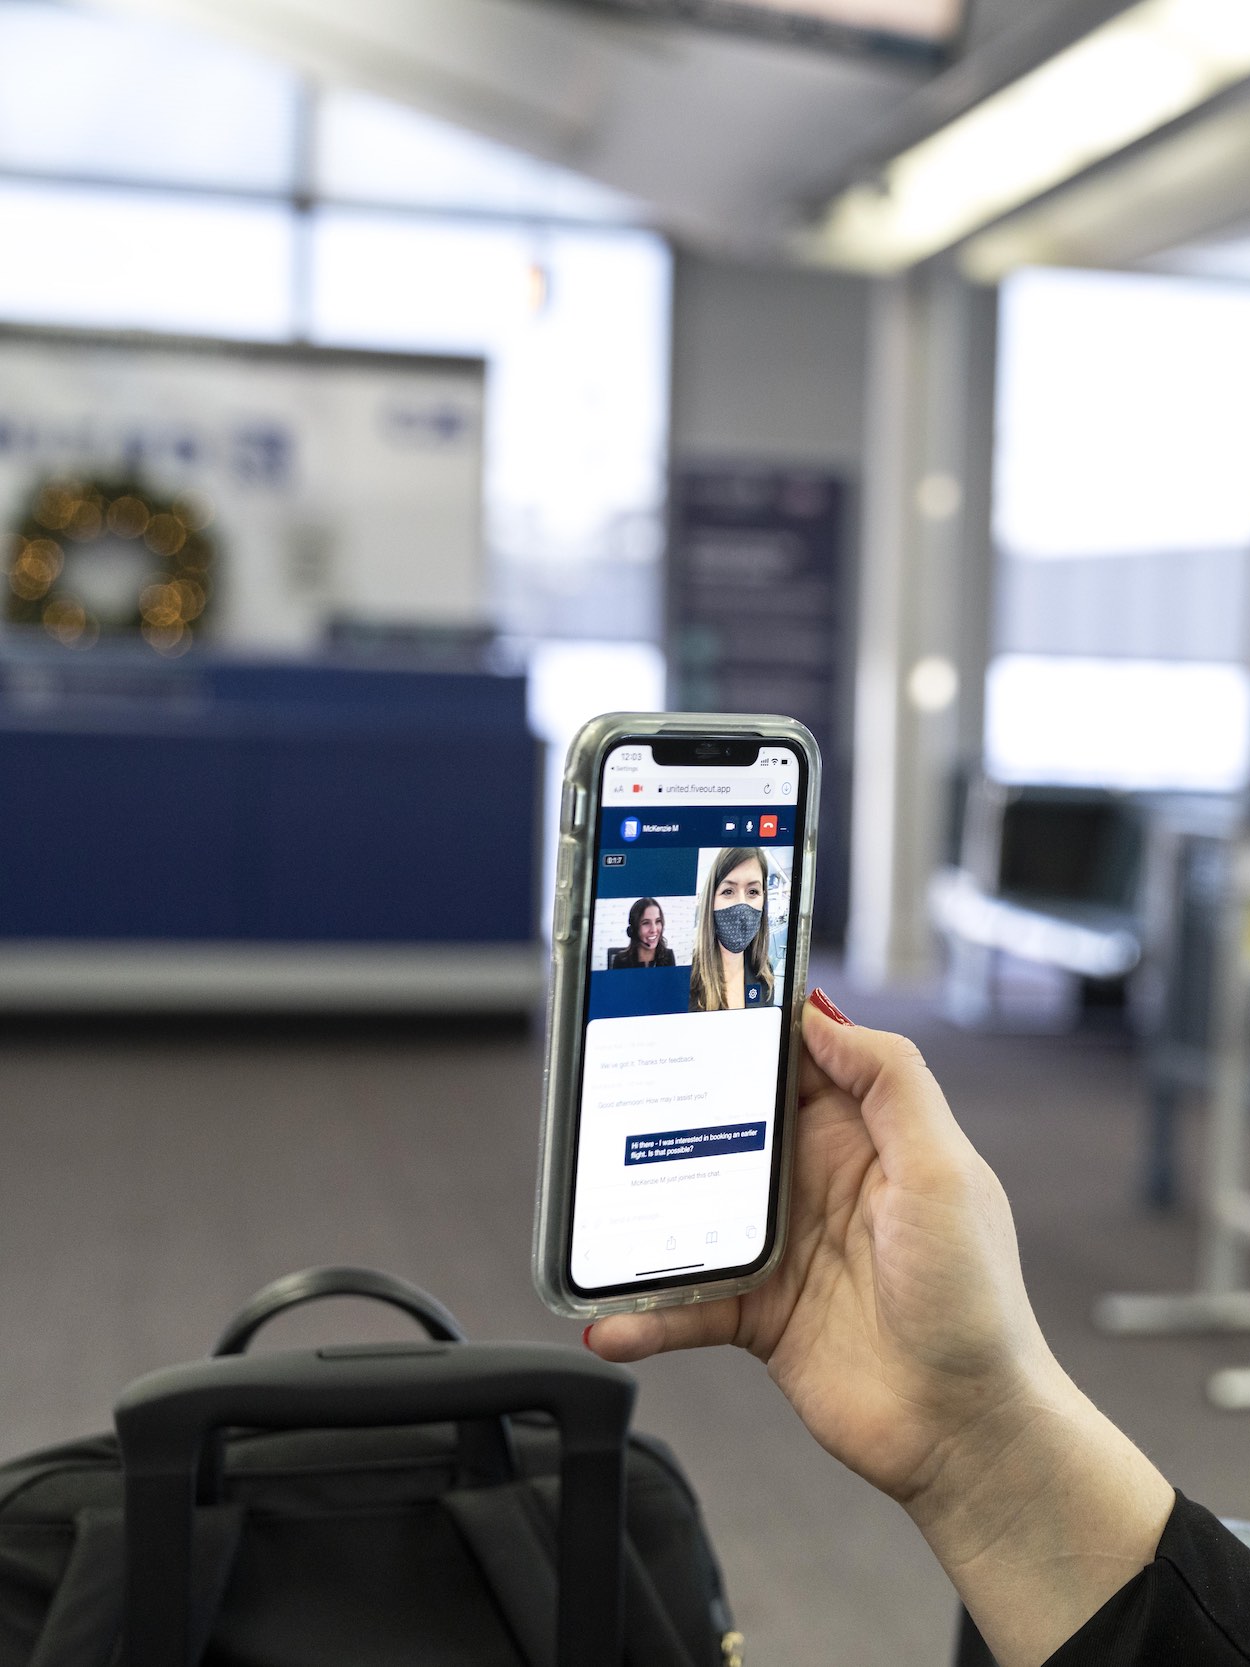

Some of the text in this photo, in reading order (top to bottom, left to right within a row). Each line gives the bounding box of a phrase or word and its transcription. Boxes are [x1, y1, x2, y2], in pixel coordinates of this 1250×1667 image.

[621, 752, 642, 761] 12:03
[666, 784, 730, 794] united.fiveout.app
[642, 824, 679, 832] McKenzie M
[619, 1060, 629, 1071] got
[637, 1058, 659, 1067] Thanks
[659, 1057, 668, 1065] for
[598, 1101, 614, 1109] Good
[645, 1096, 659, 1105] How
[660, 1096, 672, 1104] may
[676, 1093, 693, 1101] assist
[694, 1091, 709, 1101] you?
[631, 1141, 639, 1149] Hi
[639, 1140, 655, 1149] there
[662, 1138, 675, 1146] was
[675, 1134, 703, 1145] interested
[703, 1134, 709, 1142] in
[709, 1131, 732, 1141] booking
[732, 1131, 740, 1139] an
[740, 1128, 758, 1138] earlier
[630, 1144, 694, 1161] flight. Is that possible?
[666, 1175, 678, 1185] just
[678, 1172, 695, 1183] joined
[696, 1170, 707, 1179] this
